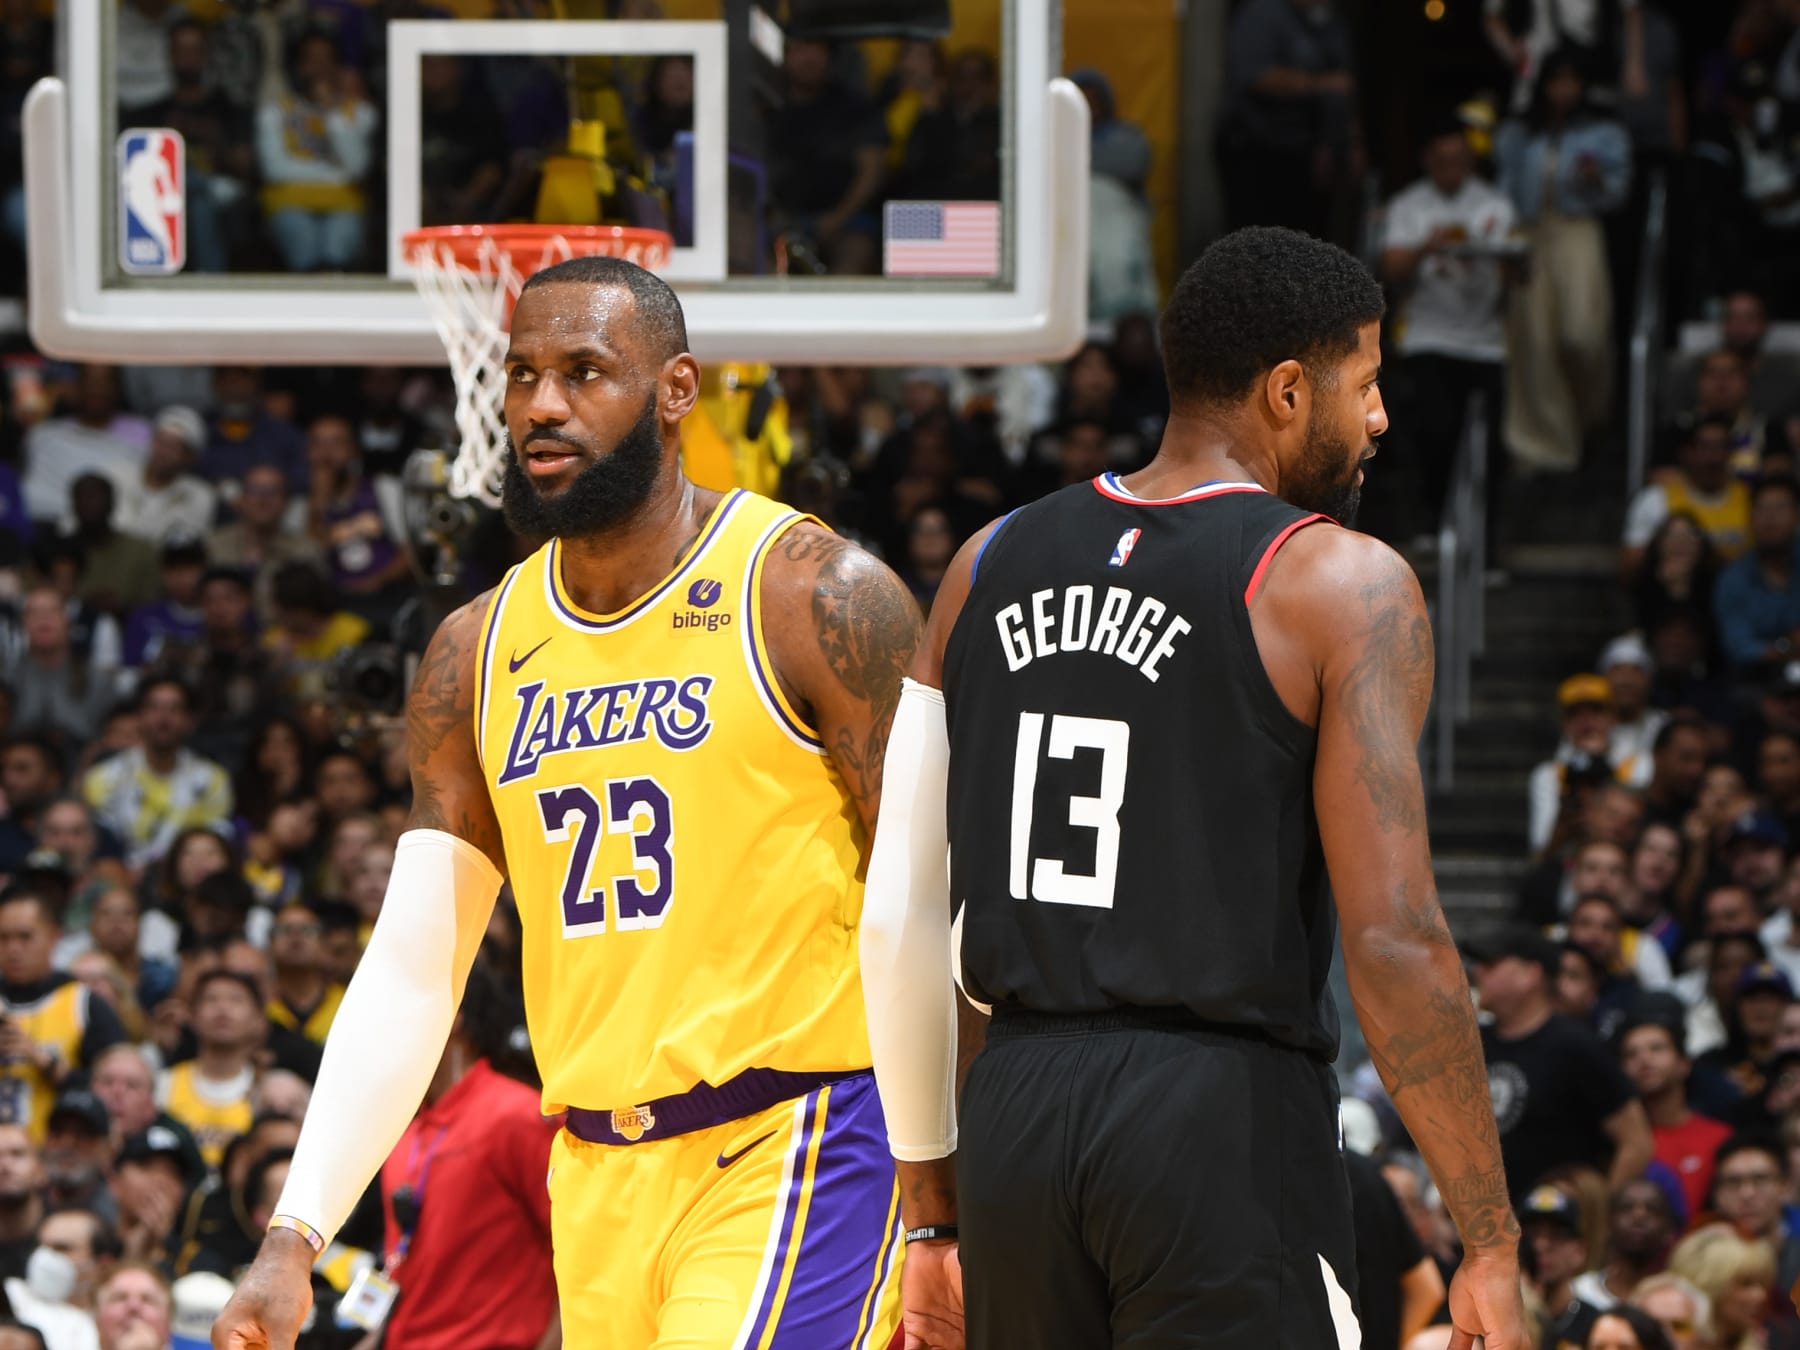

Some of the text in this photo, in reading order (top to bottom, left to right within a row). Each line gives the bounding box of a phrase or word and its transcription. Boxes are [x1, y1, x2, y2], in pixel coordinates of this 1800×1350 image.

[673, 611, 731, 631] bibigo
[995, 584, 1192, 683] GEORGE
[497, 674, 715, 787] LAKERS
[534, 775, 675, 939] 23
[1009, 711, 1130, 909] 13
